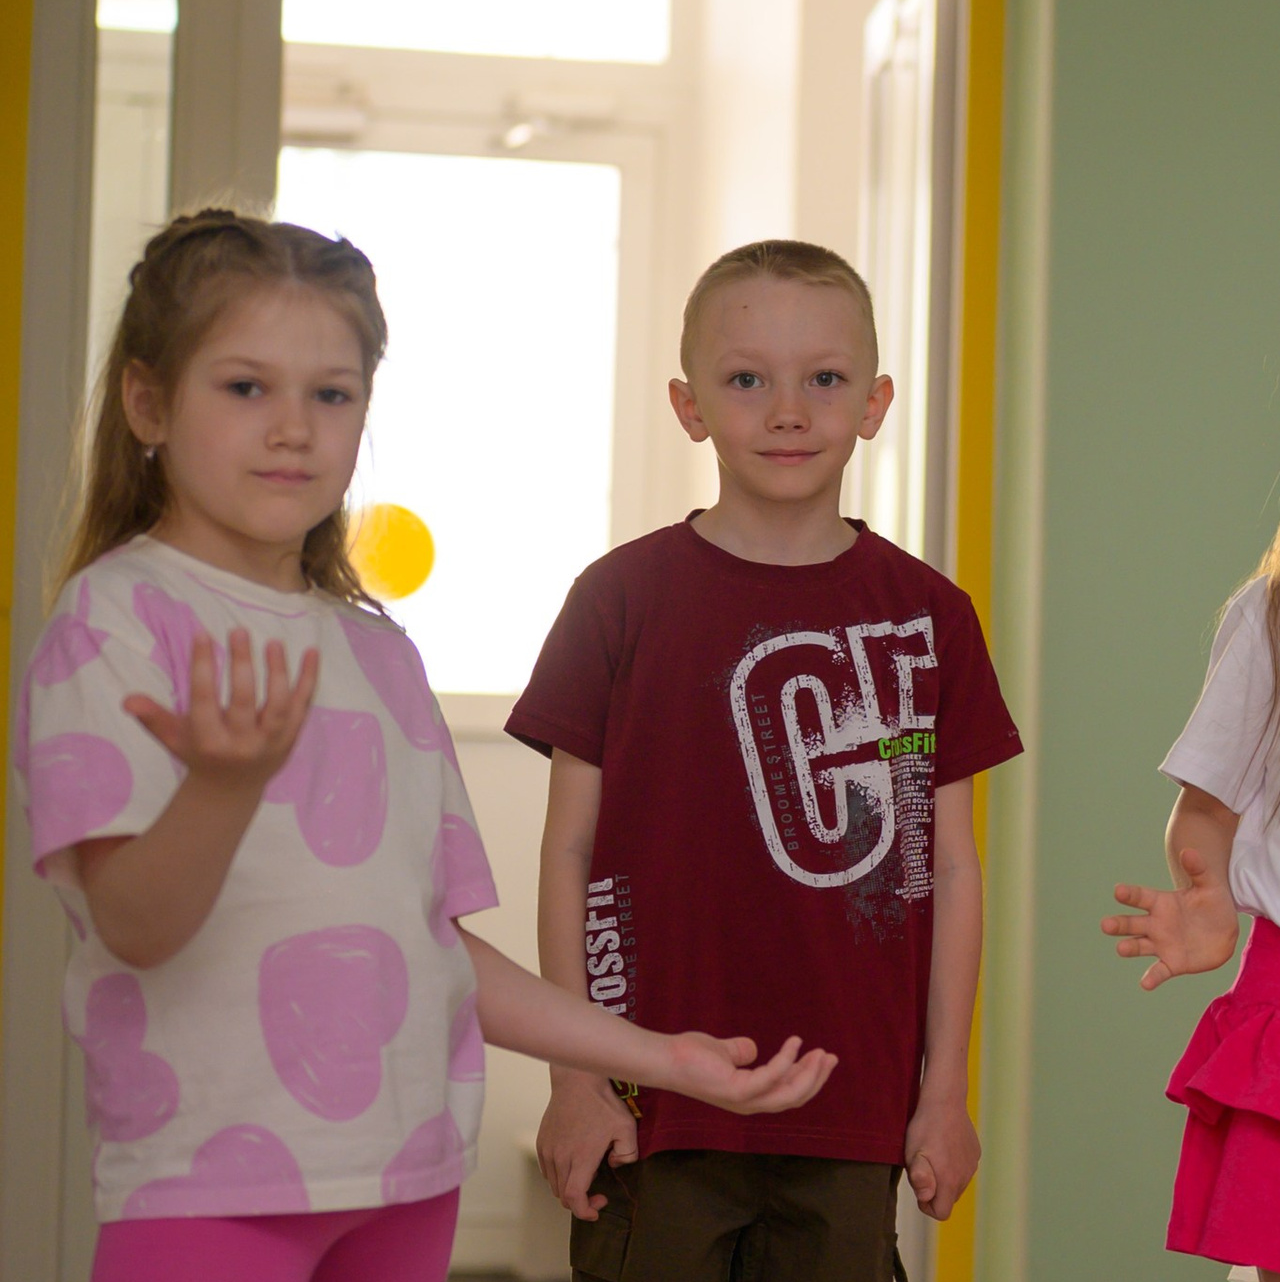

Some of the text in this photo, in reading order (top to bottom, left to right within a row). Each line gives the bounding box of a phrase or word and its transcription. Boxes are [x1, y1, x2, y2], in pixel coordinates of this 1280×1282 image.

[751, 693, 780, 765] STREET
[771, 770, 799, 851] BROOME
[615, 873, 638, 1022] ROOME STREET
